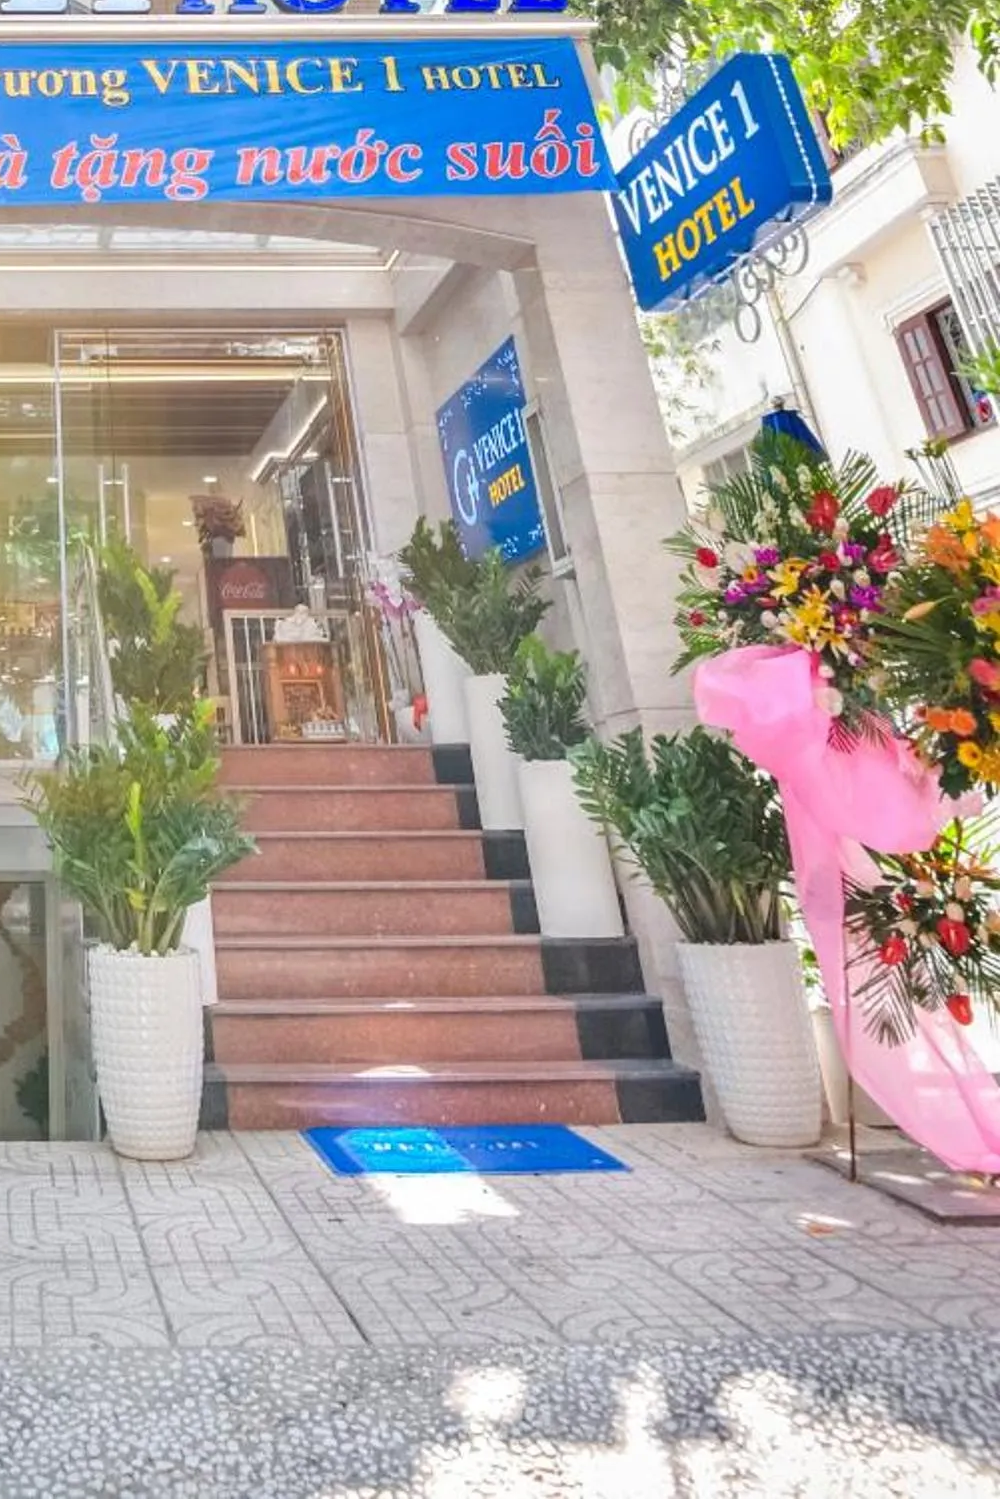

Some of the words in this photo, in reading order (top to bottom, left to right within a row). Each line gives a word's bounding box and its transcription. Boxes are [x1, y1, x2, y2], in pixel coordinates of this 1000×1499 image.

[139, 56, 363, 94] VENICE
[377, 55, 405, 92] 1
[420, 63, 561, 91] HOTEL
[50, 133, 215, 202] tặng
[236, 128, 423, 185] nước
[446, 108, 601, 181] suối
[652, 176, 756, 282] HOTEL
[488, 463, 527, 508] HOTEL
